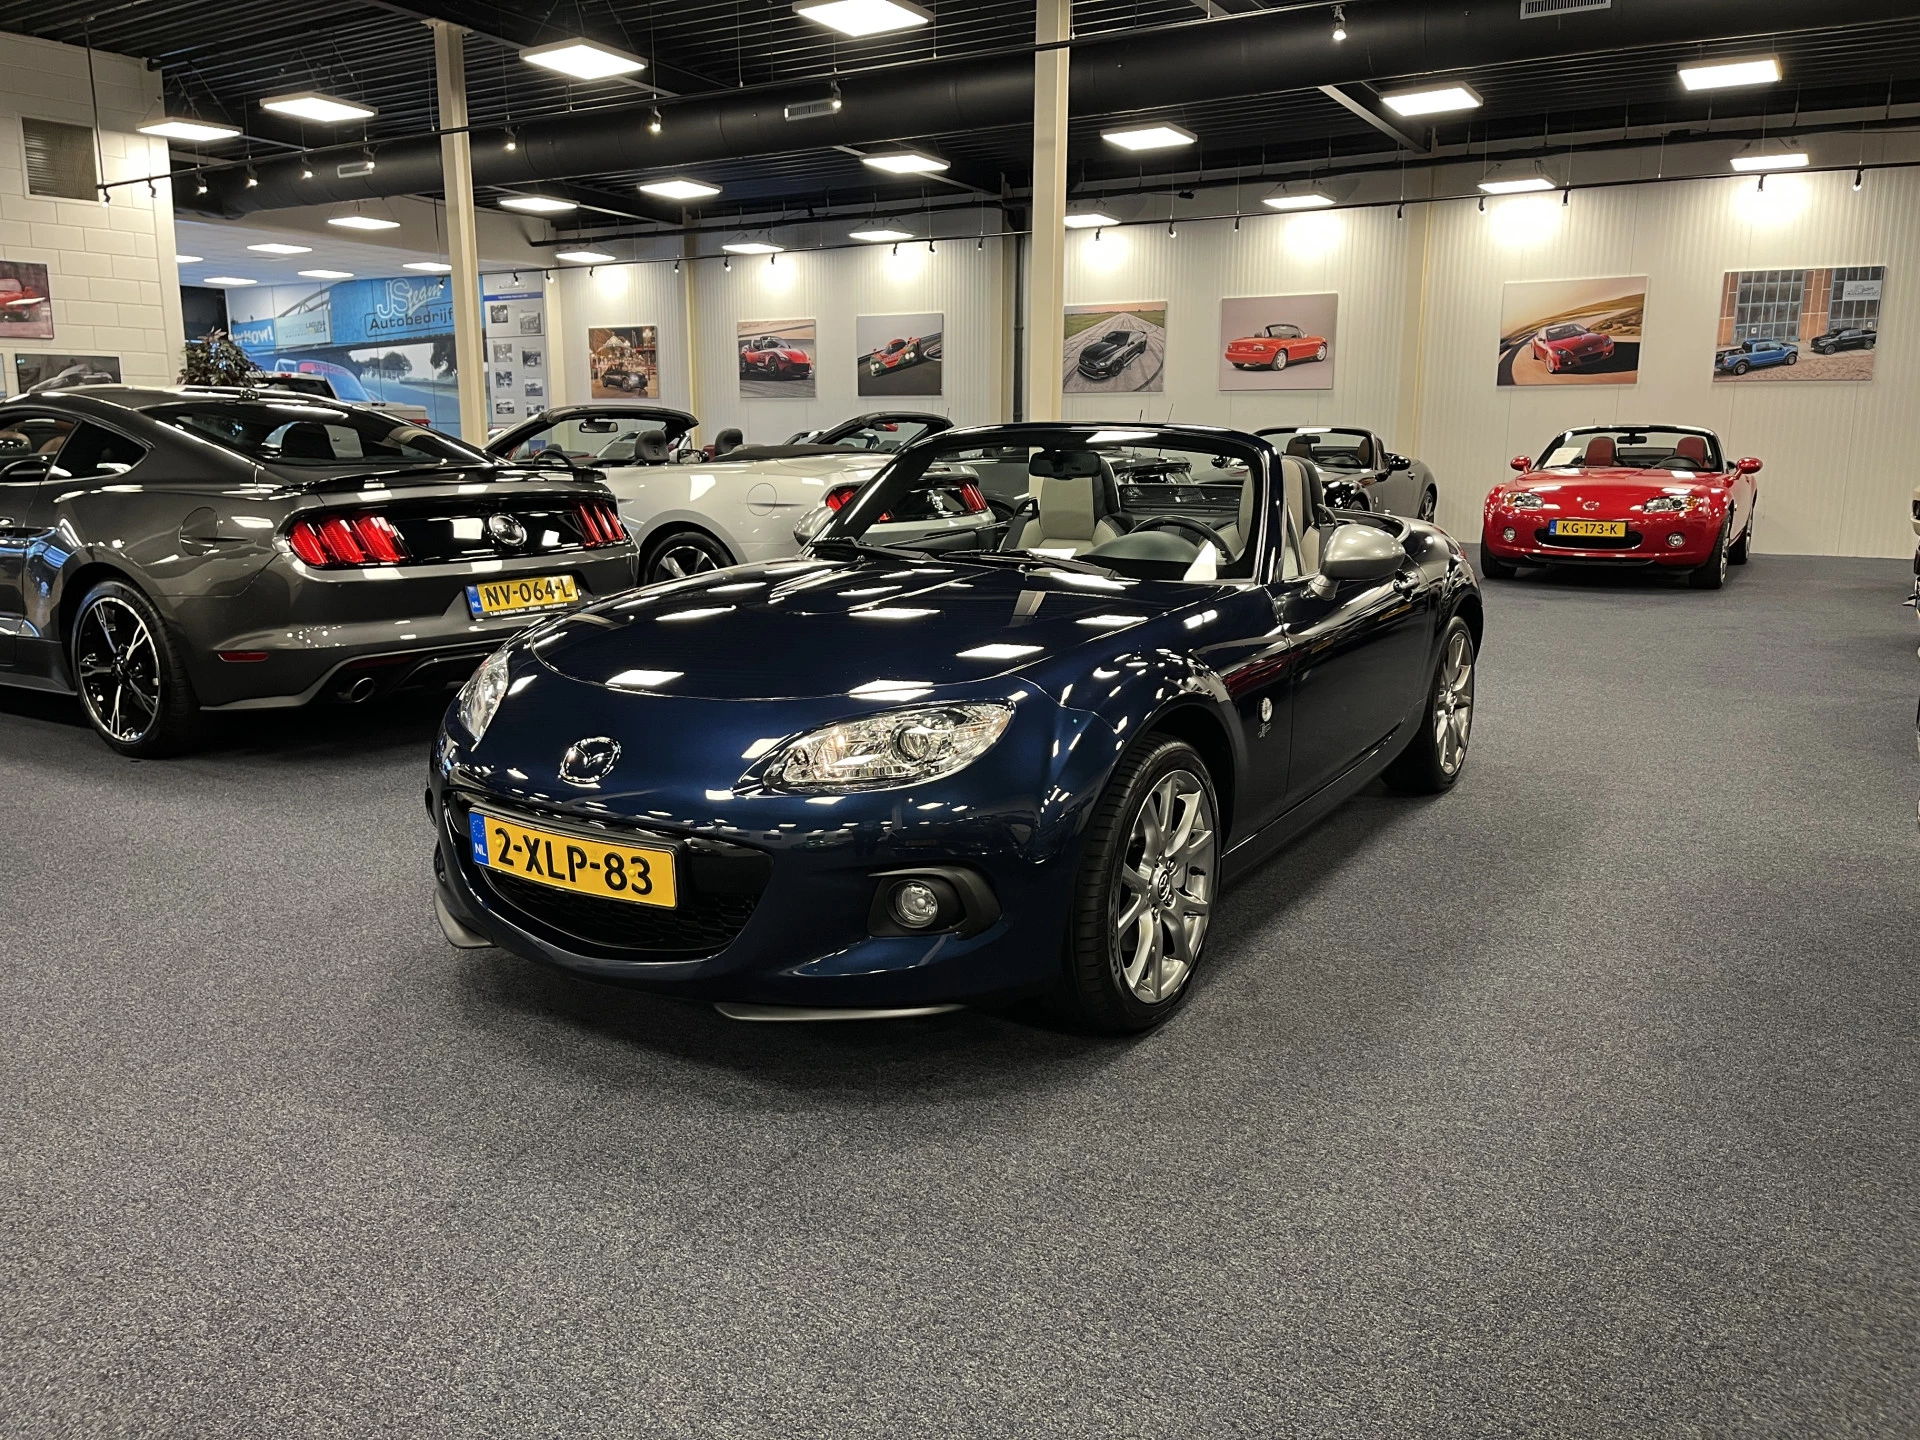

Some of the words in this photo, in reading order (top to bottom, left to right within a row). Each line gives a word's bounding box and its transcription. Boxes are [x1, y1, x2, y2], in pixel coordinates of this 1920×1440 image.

[369, 308, 454, 331] Autobedrijf
[1562, 523, 1617, 535] KG-173-K
[484, 578, 573, 607] NV-064-L
[474, 842, 487, 857] NL
[495, 827, 653, 896] 2-XLP-83
